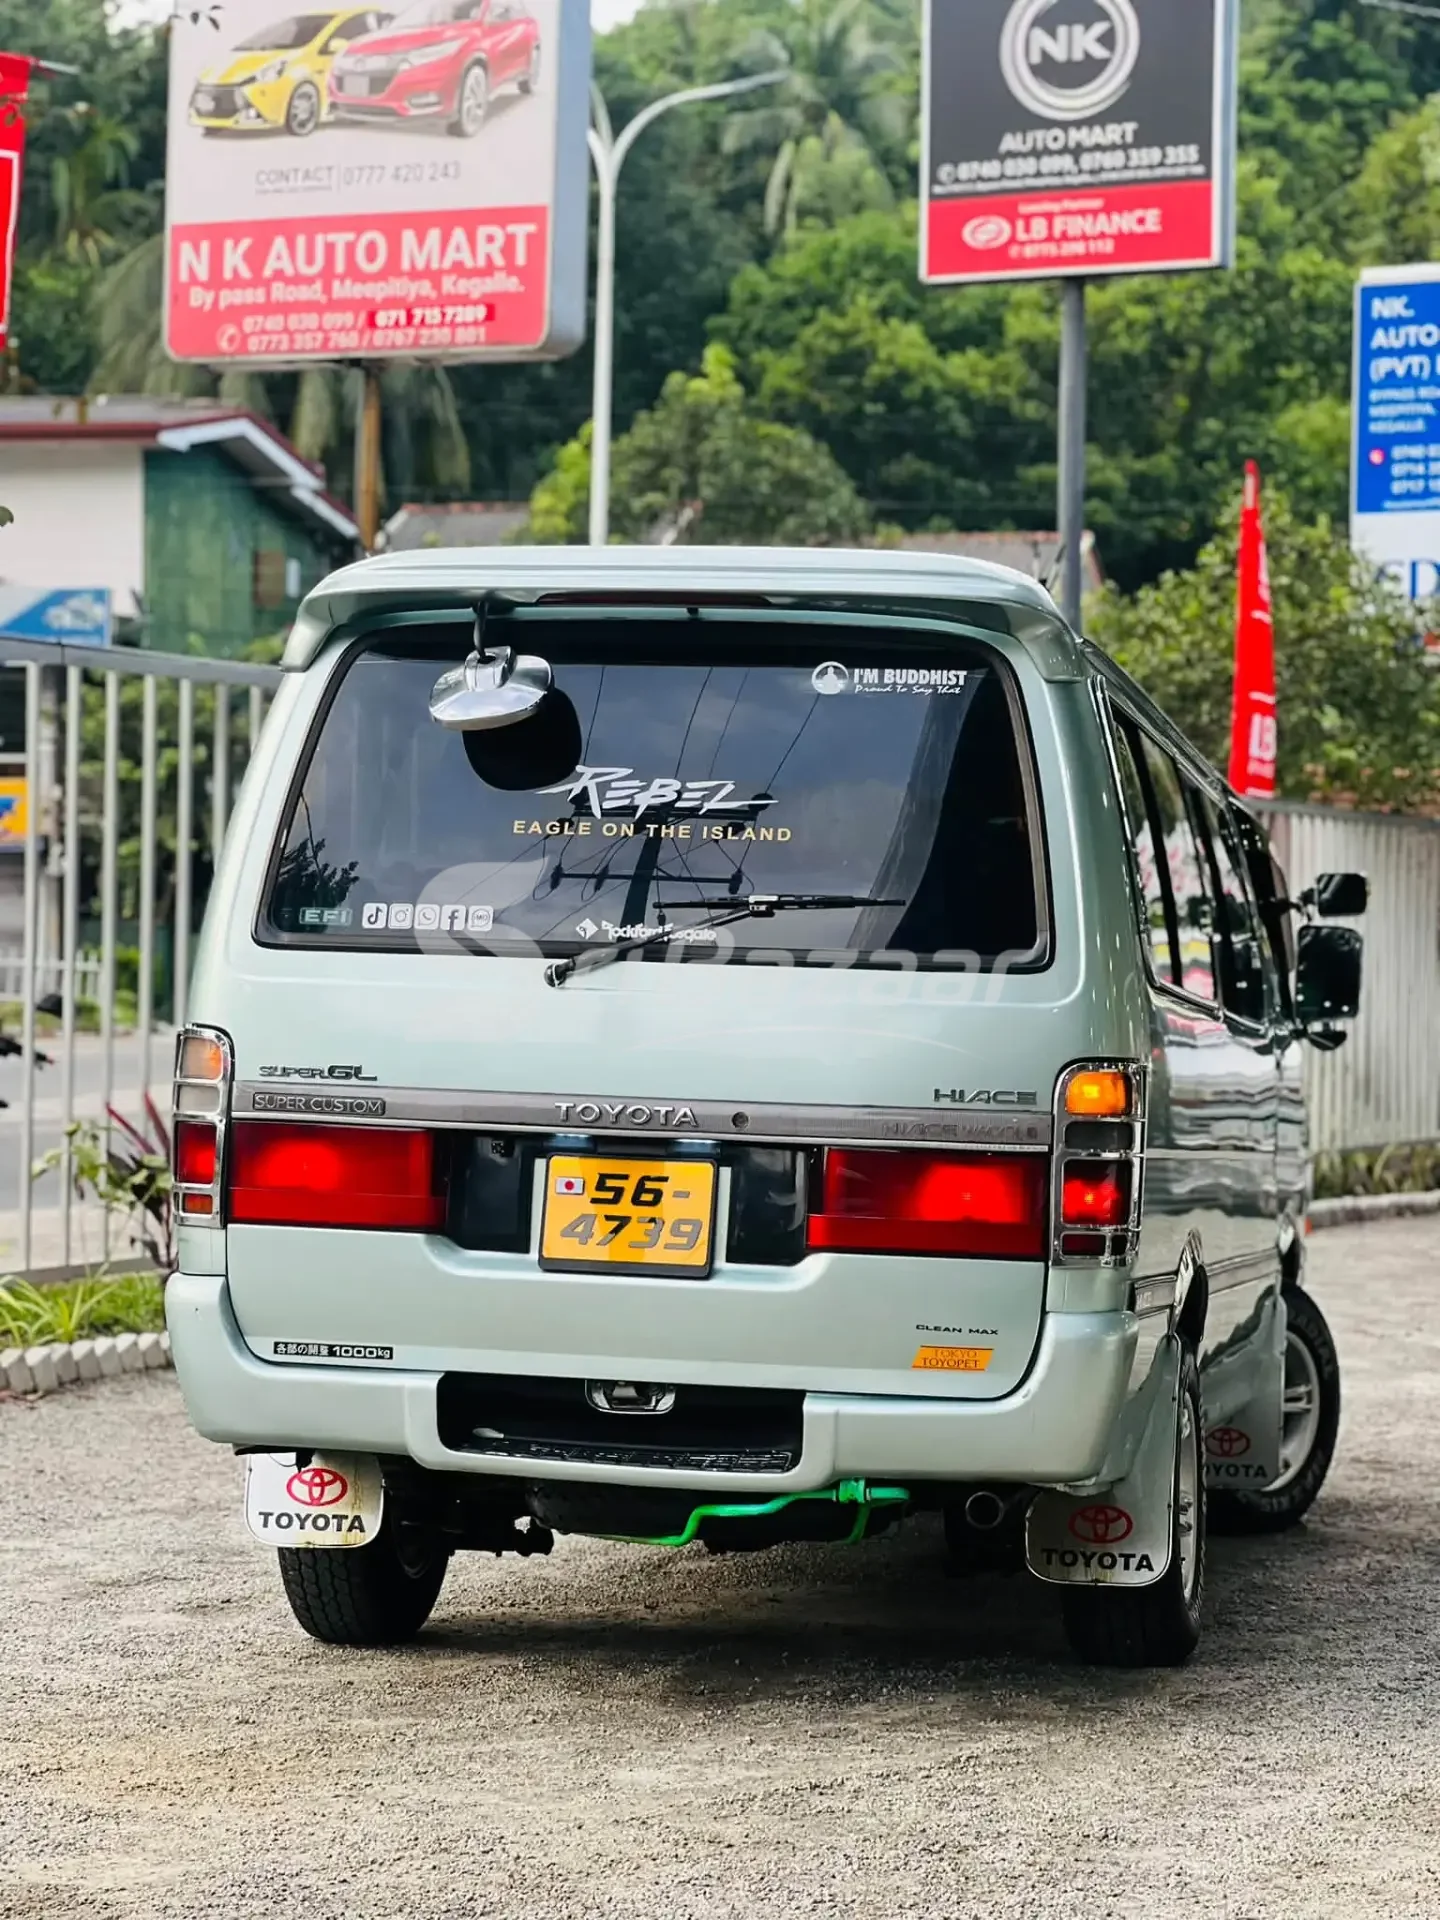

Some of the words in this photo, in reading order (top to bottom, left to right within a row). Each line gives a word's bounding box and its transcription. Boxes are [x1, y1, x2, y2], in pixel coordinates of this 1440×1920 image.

[1028, 20, 1113, 65] NK
[998, 127, 1066, 155] AUTO
[1067, 121, 1139, 149] MART
[1015, 216, 1049, 242] LB
[1052, 207, 1163, 241] FINANCE
[178, 240, 210, 284] N
[222, 238, 254, 281] K
[262, 229, 388, 279] AUTO
[400, 223, 538, 272] MART
[189, 285, 215, 312] By
[853, 668, 878, 684] I'M
[883, 668, 967, 686] BUDDHIST
[854, 684, 893, 694] Proud
[896, 685, 907, 694] To
[911, 685, 933, 696] Say
[937, 685, 961, 694] That
[535, 765, 780, 820] REBEL
[513, 820, 592, 836] EAGLE
[602, 821, 635, 838] ON
[648, 823, 691, 840] THE
[702, 825, 792, 842] ISLAND
[303, 908, 348, 923] EFI
[254, 1093, 305, 1110] SUPER
[309, 1097, 382, 1113] CUSTOM
[933, 1088, 1037, 1105] HIACE
[554, 1102, 699, 1128] TOYOTA
[559, 1213, 703, 1251] 4739
[915, 1324, 963, 1334] CLEAN
[331, 1345, 391, 1359] 1000kg
[919, 1357, 980, 1369] TOYOPET
[931, 1349, 977, 1359] TOKYO
[258, 1511, 366, 1533] TOYOTA
[1040, 1548, 1155, 1573] TOYOTA
